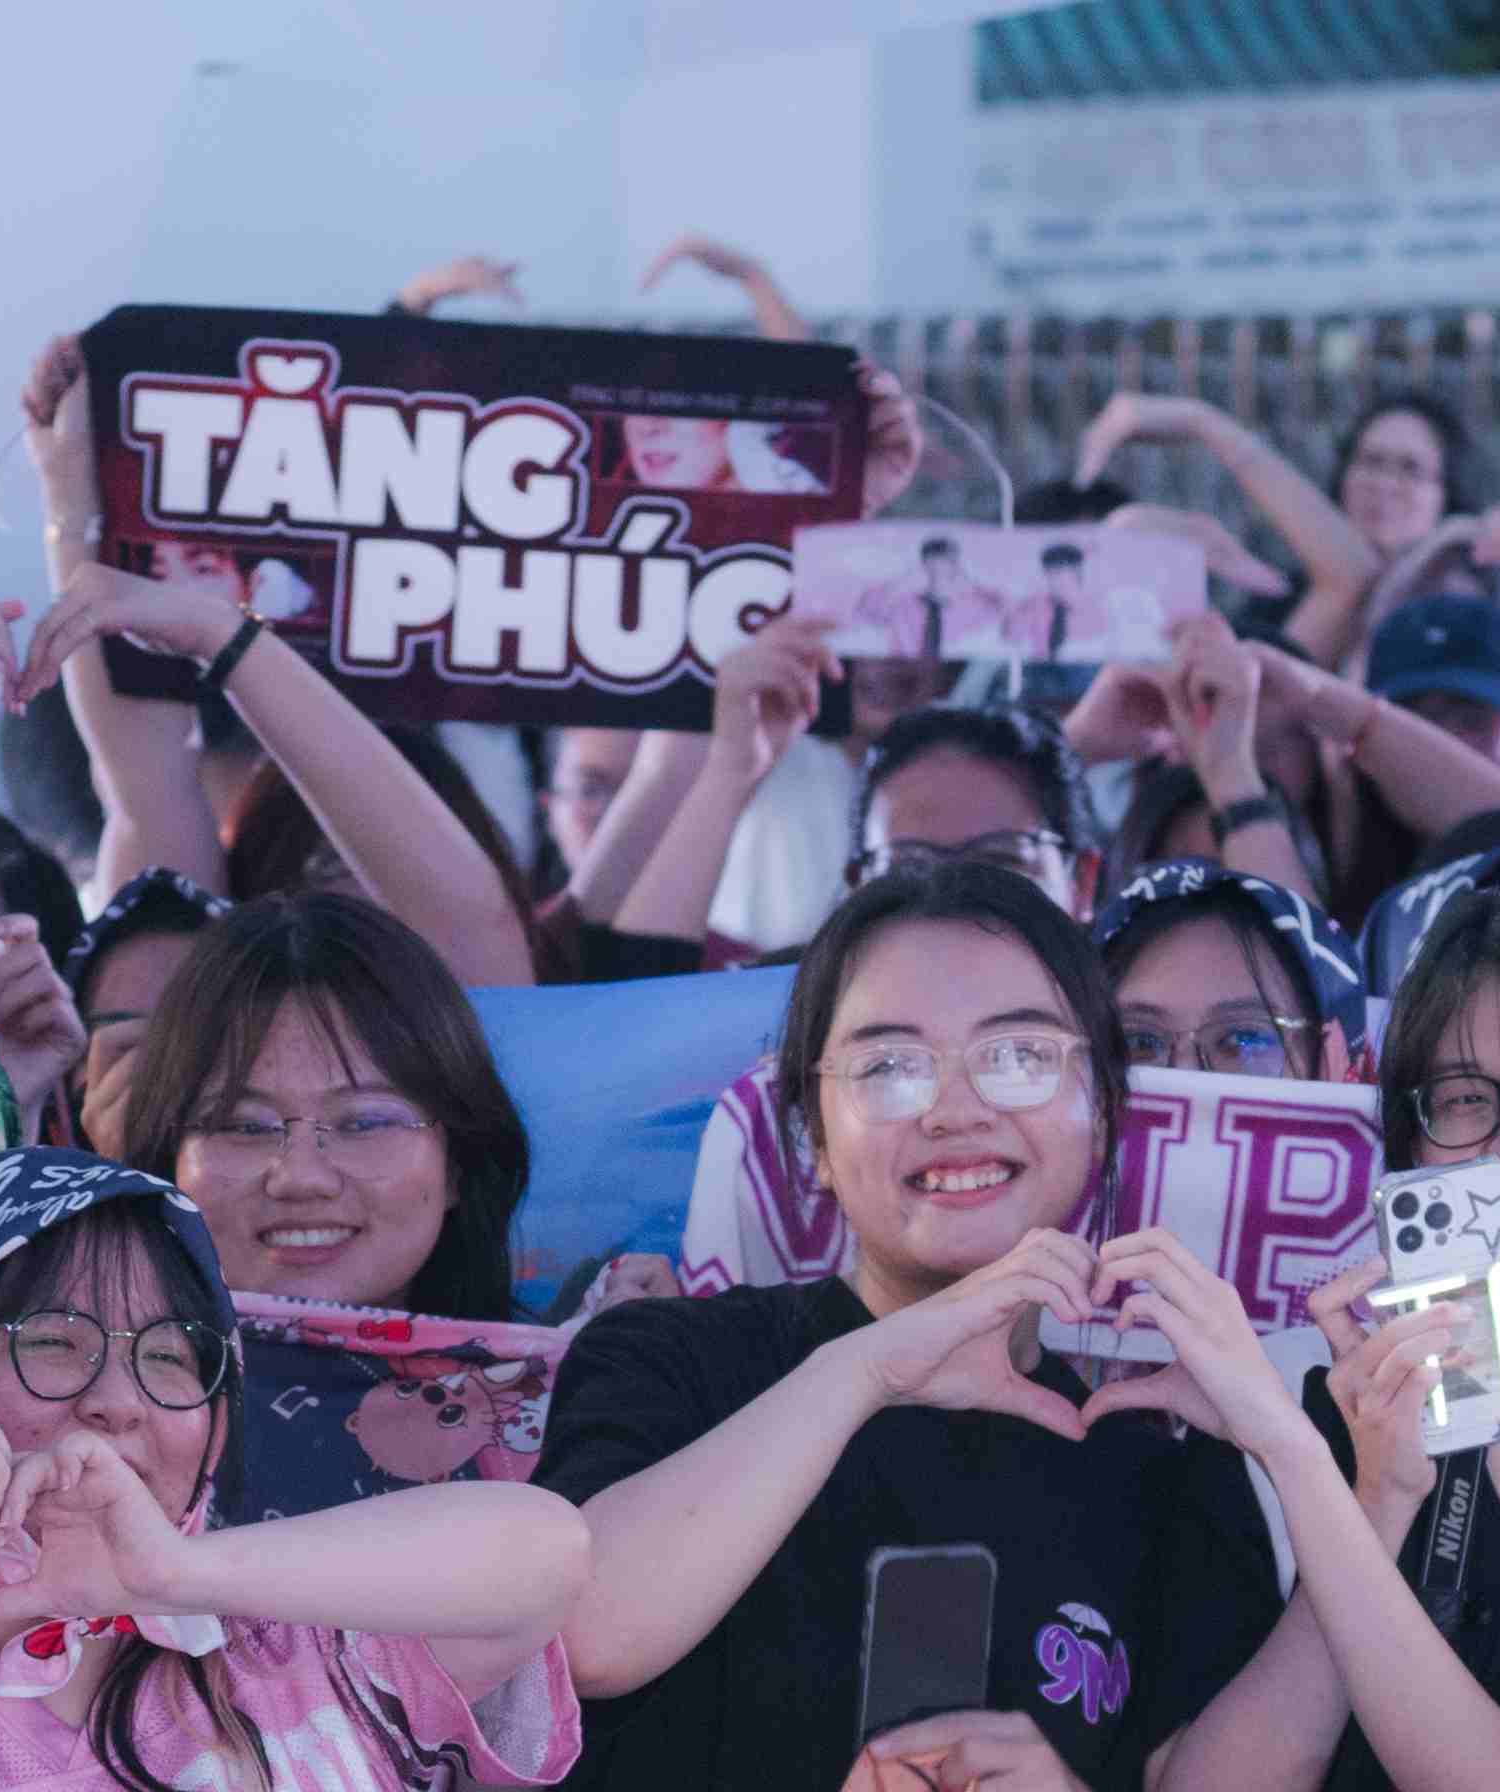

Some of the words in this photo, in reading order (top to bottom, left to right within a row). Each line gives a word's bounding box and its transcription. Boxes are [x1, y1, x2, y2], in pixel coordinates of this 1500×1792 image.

[130, 352, 576, 542] TĂNG
[346, 508, 792, 678] PHÚC
[1435, 1477, 1472, 1562] Nikon
